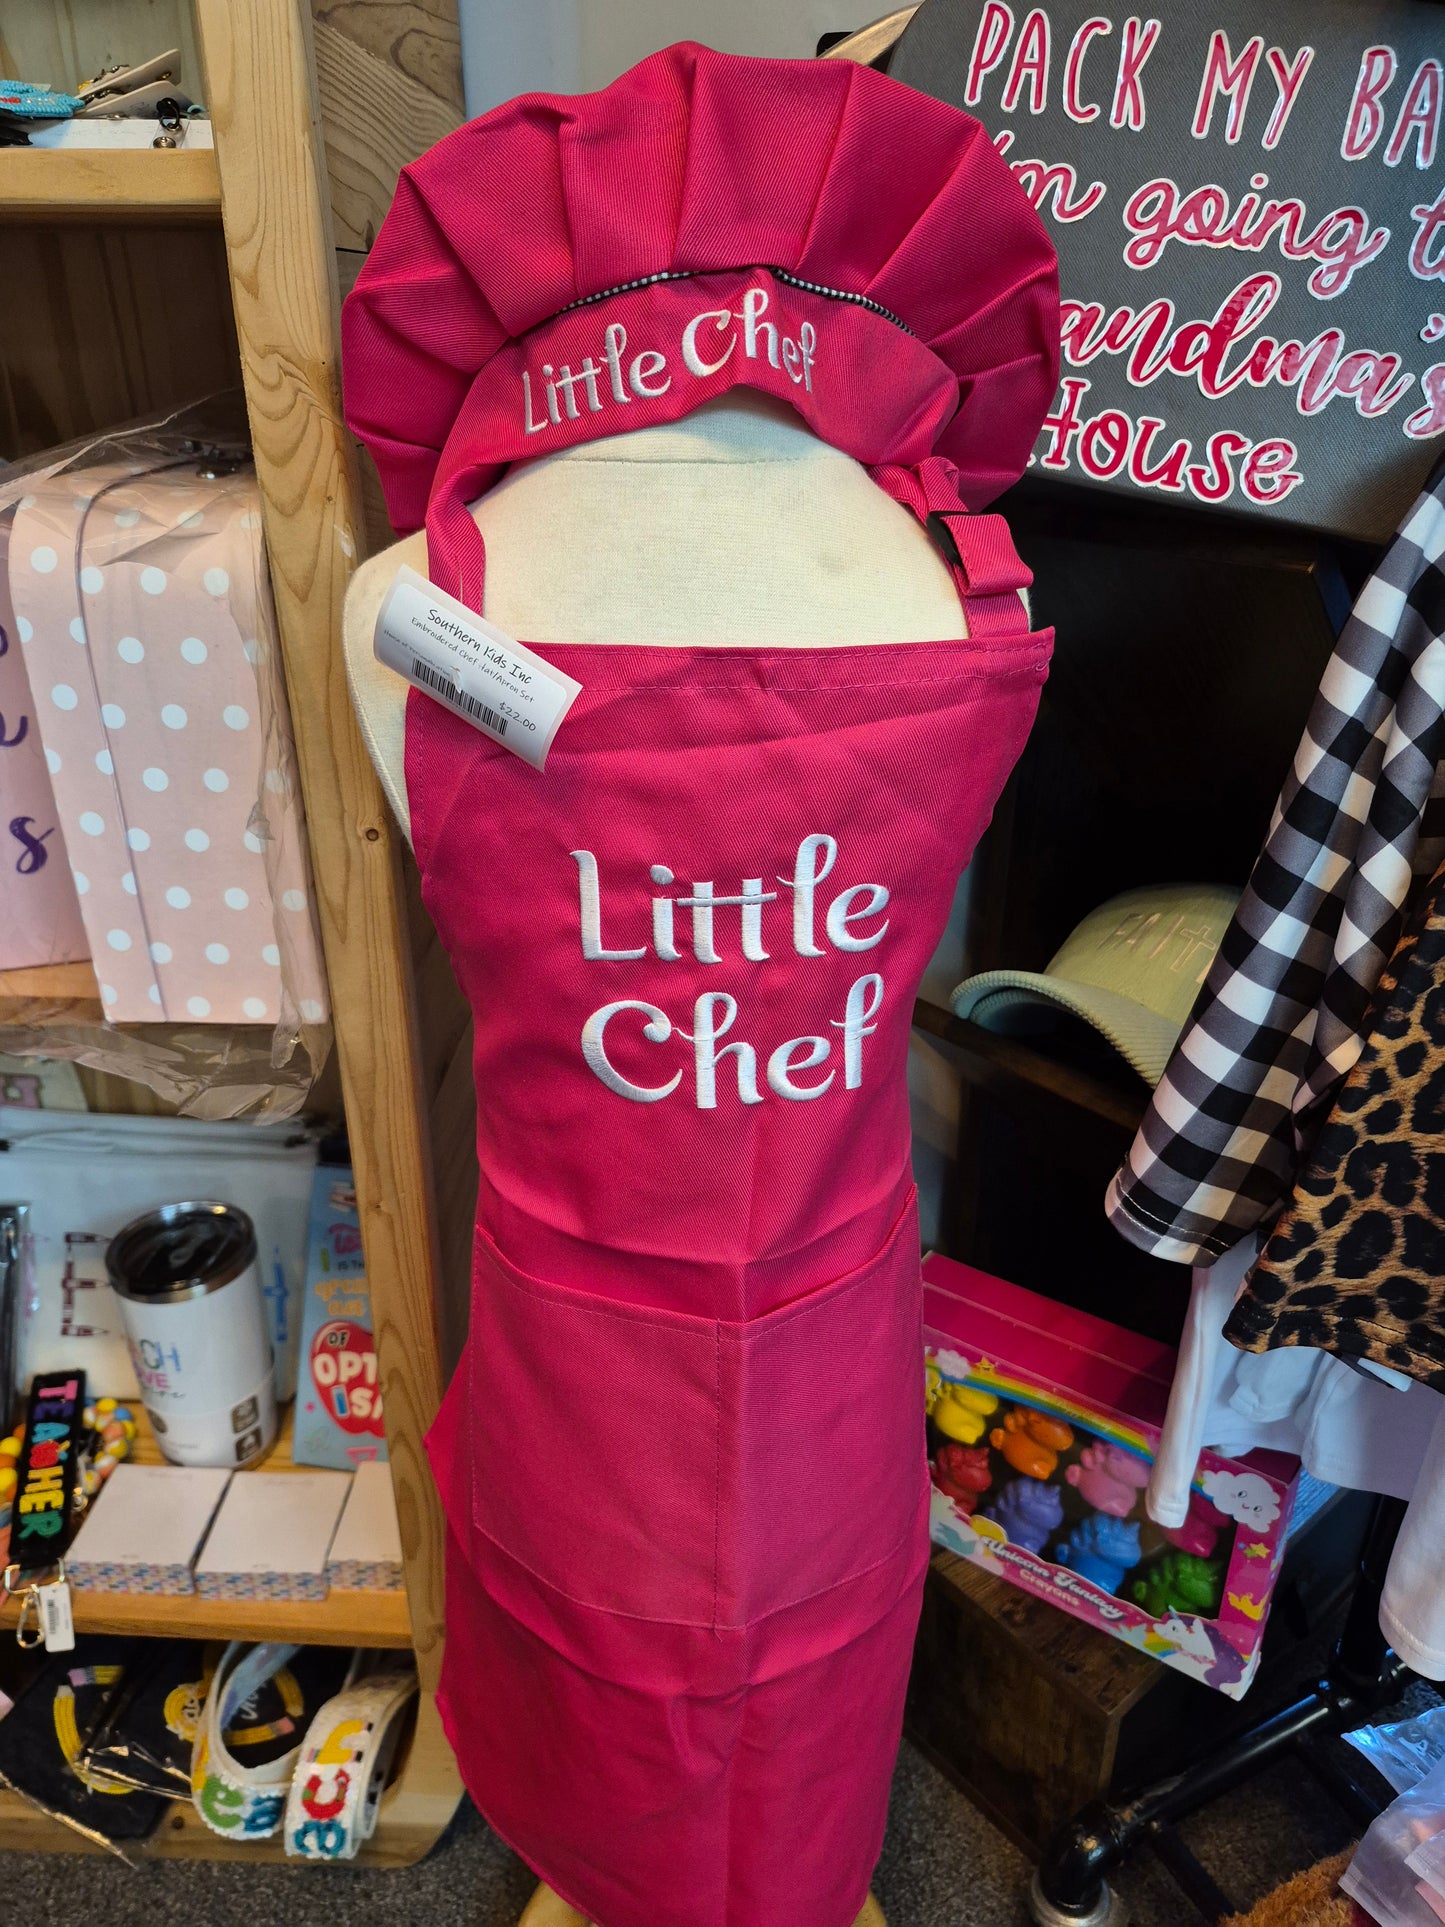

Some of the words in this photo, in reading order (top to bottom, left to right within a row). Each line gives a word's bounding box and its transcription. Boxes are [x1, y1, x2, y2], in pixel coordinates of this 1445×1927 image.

[964, 1, 1163, 131] PACK
[1190, 30, 1316, 150] MY
[1340, 45, 1444, 170] BA
[1122, 173, 1390, 300] going
[1408, 182, 1445, 282] t
[522, 323, 671, 436] Little
[681, 288, 816, 394] Chef
[1060, 272, 1445, 440] andma's
[1020, 378, 1304, 505] House
[411, 617, 458, 652] Embroidered
[458, 649, 479, 665] Chef
[519, 689, 535, 703] Set
[427, 609, 480, 652] Southern
[483, 645, 507, 669] Kids
[508, 662, 533, 685] Inc
[499, 700, 537, 731] $22.00
[569, 833, 890, 963] Little
[581, 973, 884, 1109] Chef
[313, 1351, 378, 1386] OPT
